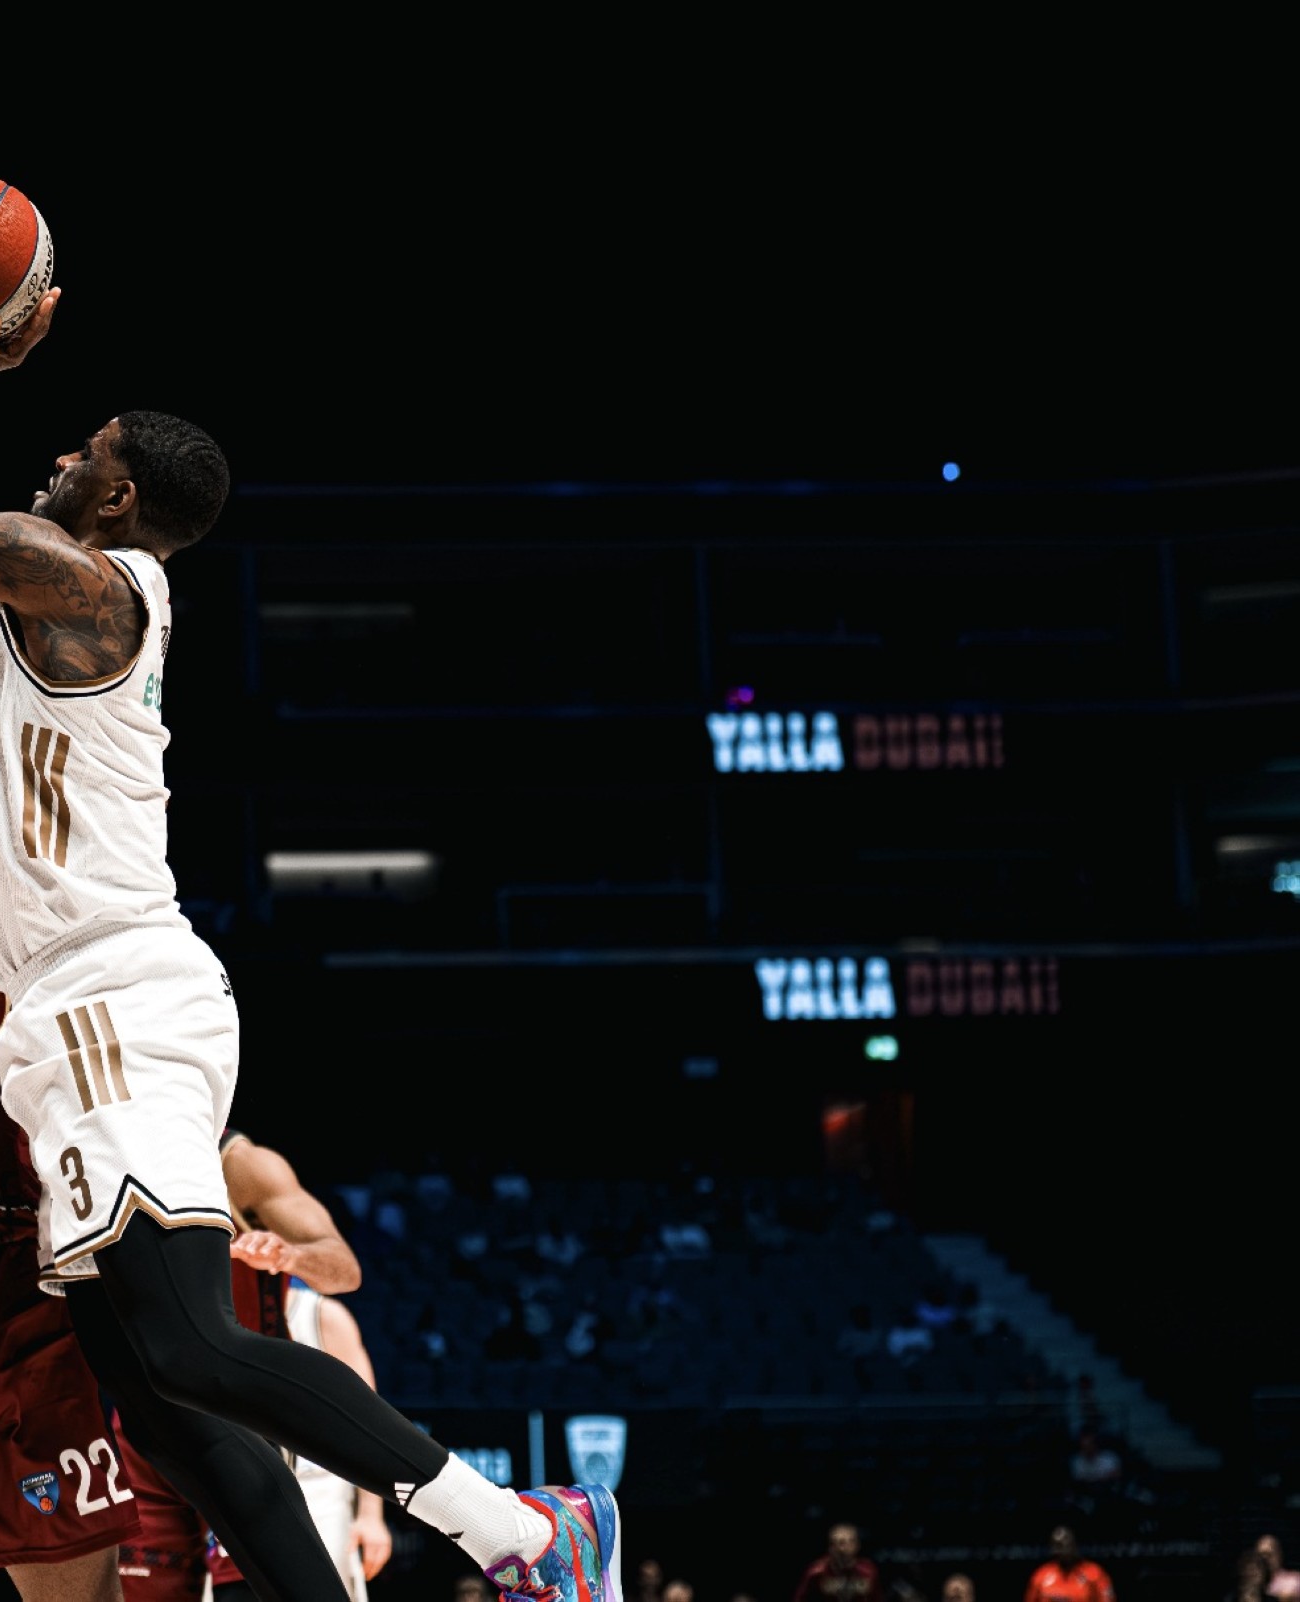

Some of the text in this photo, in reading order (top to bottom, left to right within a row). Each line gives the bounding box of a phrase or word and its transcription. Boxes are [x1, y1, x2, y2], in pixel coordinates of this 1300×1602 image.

[706, 711, 1004, 773] YALLA DUBAI!
[753, 956, 1060, 1021] YALLA DUBAI!
[59, 1146, 94, 1222] 3
[59, 1437, 135, 1517] 22
